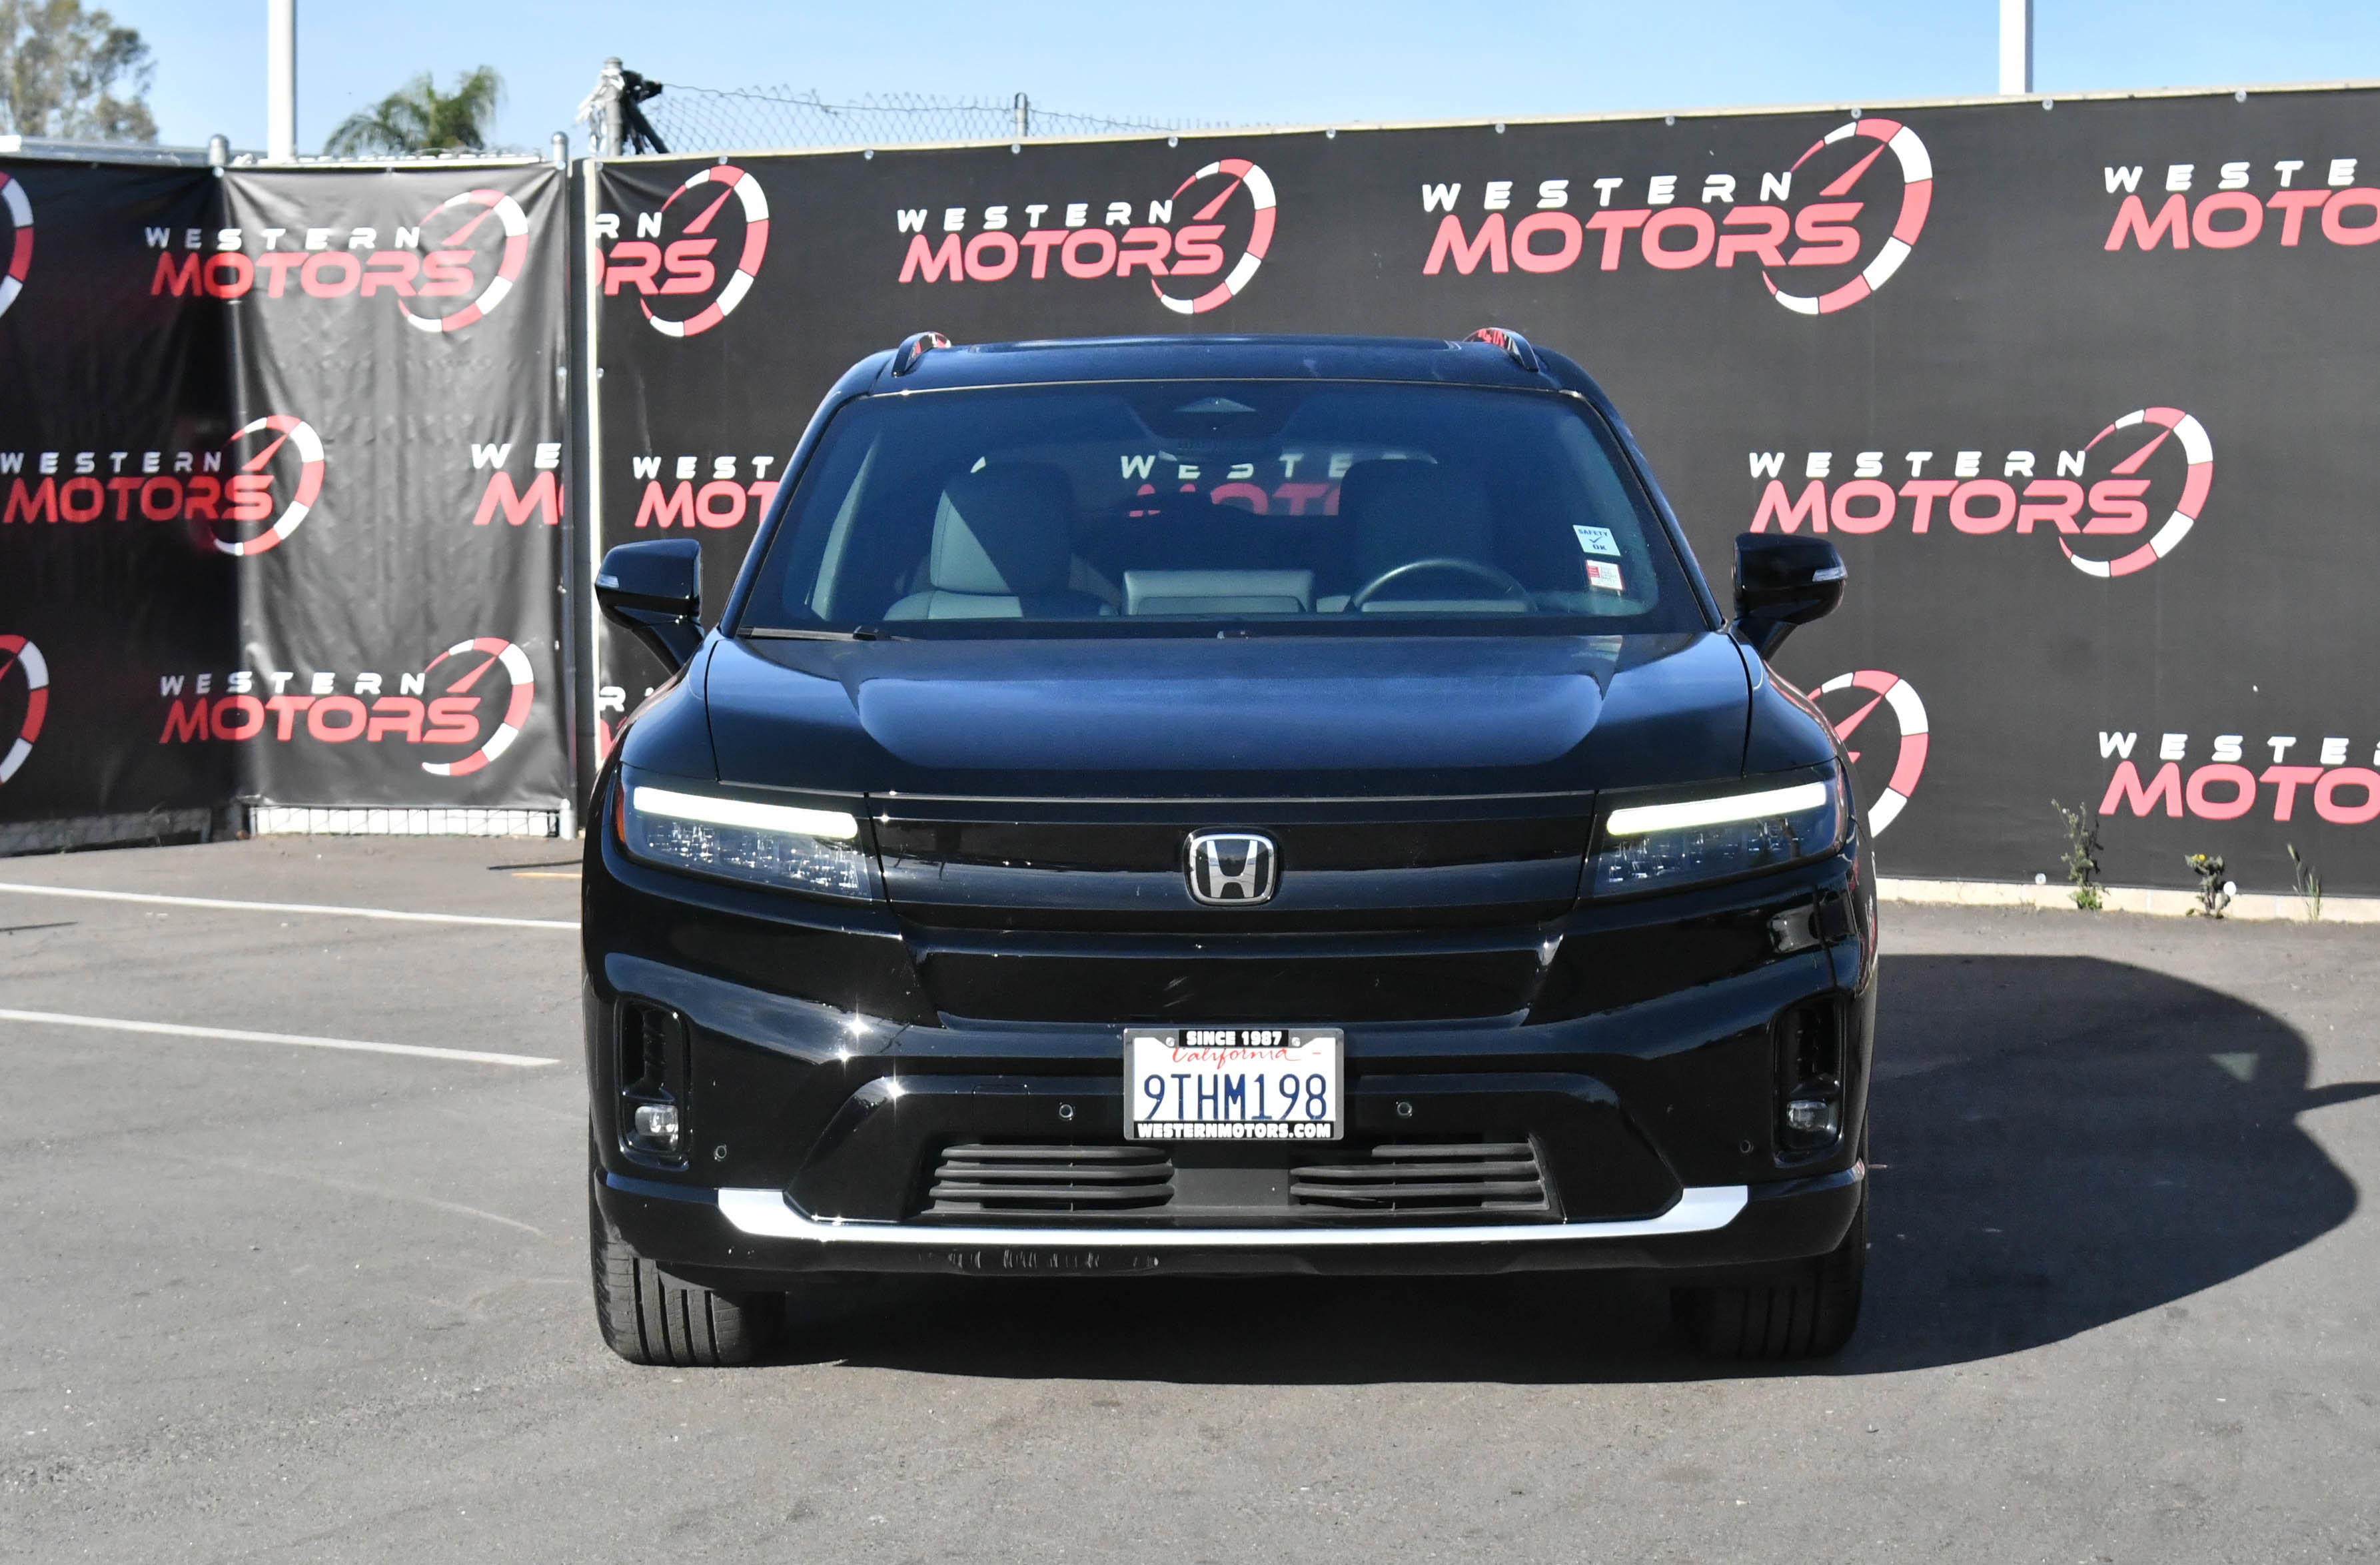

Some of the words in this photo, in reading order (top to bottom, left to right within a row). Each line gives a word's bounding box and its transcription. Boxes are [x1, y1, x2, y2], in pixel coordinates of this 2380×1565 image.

[1423, 171, 1792, 213] WESTERN
[2104, 158, 2358, 193] WESTE
[897, 199, 1173, 233] WESTERN
[2104, 187, 2380, 251] MOTO
[145, 226, 420, 251] WESTERN
[898, 224, 1227, 284] MOTORS
[1423, 202, 1864, 275] MOTORS
[150, 250, 476, 299] MOTORS
[595, 239, 718, 296] RS
[0, 452, 222, 474] WESTERN
[632, 456, 774, 480] WEST
[1749, 450, 2086, 478] WESTERN
[3, 474, 275, 524] MOTORS
[472, 470, 565, 526] M
[1749, 478, 2152, 535] MOTORS
[160, 672, 426, 695] WESTERN
[159, 694, 481, 744] MOTORS
[2098, 731, 2380, 766] WESTE
[2098, 760, 2380, 825] MOTO
[1172, 1047, 1301, 1070] California
[1186, 1031, 1237, 1046] SINCE
[1241, 1031, 1283, 1046] 1987
[1143, 1073, 1327, 1120] 9THM198
[1137, 1123, 1331, 1139] WESTERNMOTORS.COM
